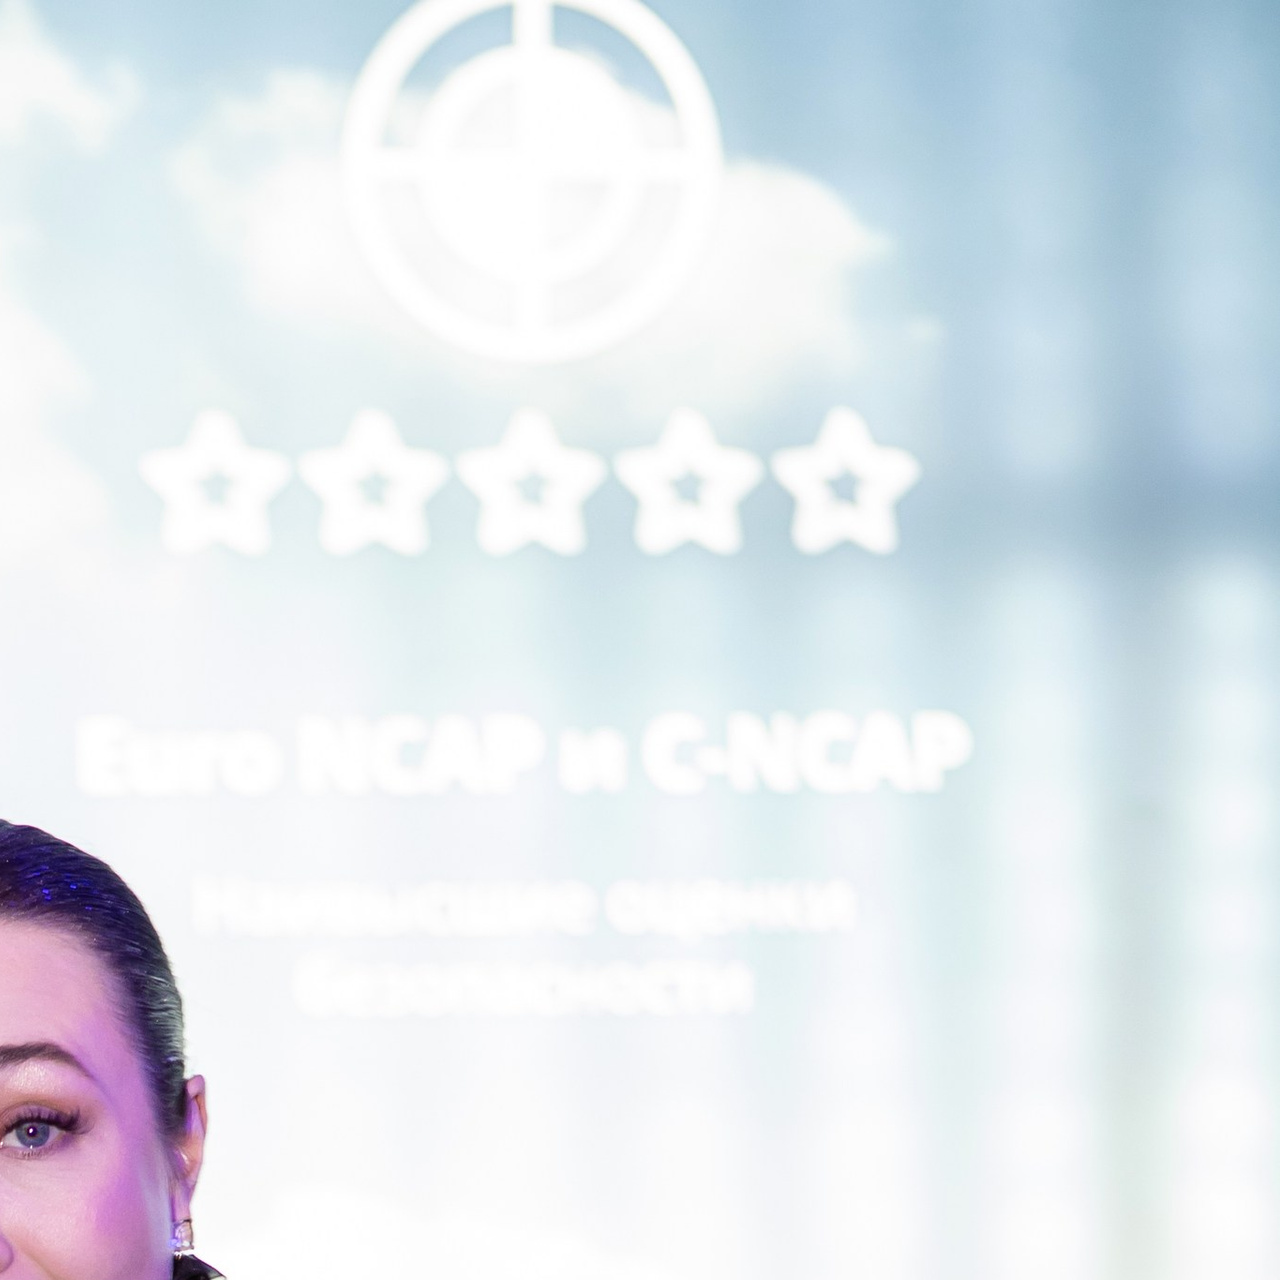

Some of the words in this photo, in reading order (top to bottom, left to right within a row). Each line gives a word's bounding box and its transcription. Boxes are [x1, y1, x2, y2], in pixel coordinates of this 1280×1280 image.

[76, 714, 282, 796] Euro
[297, 713, 543, 796] NCAP
[643, 708, 972, 795] C-NCAP
